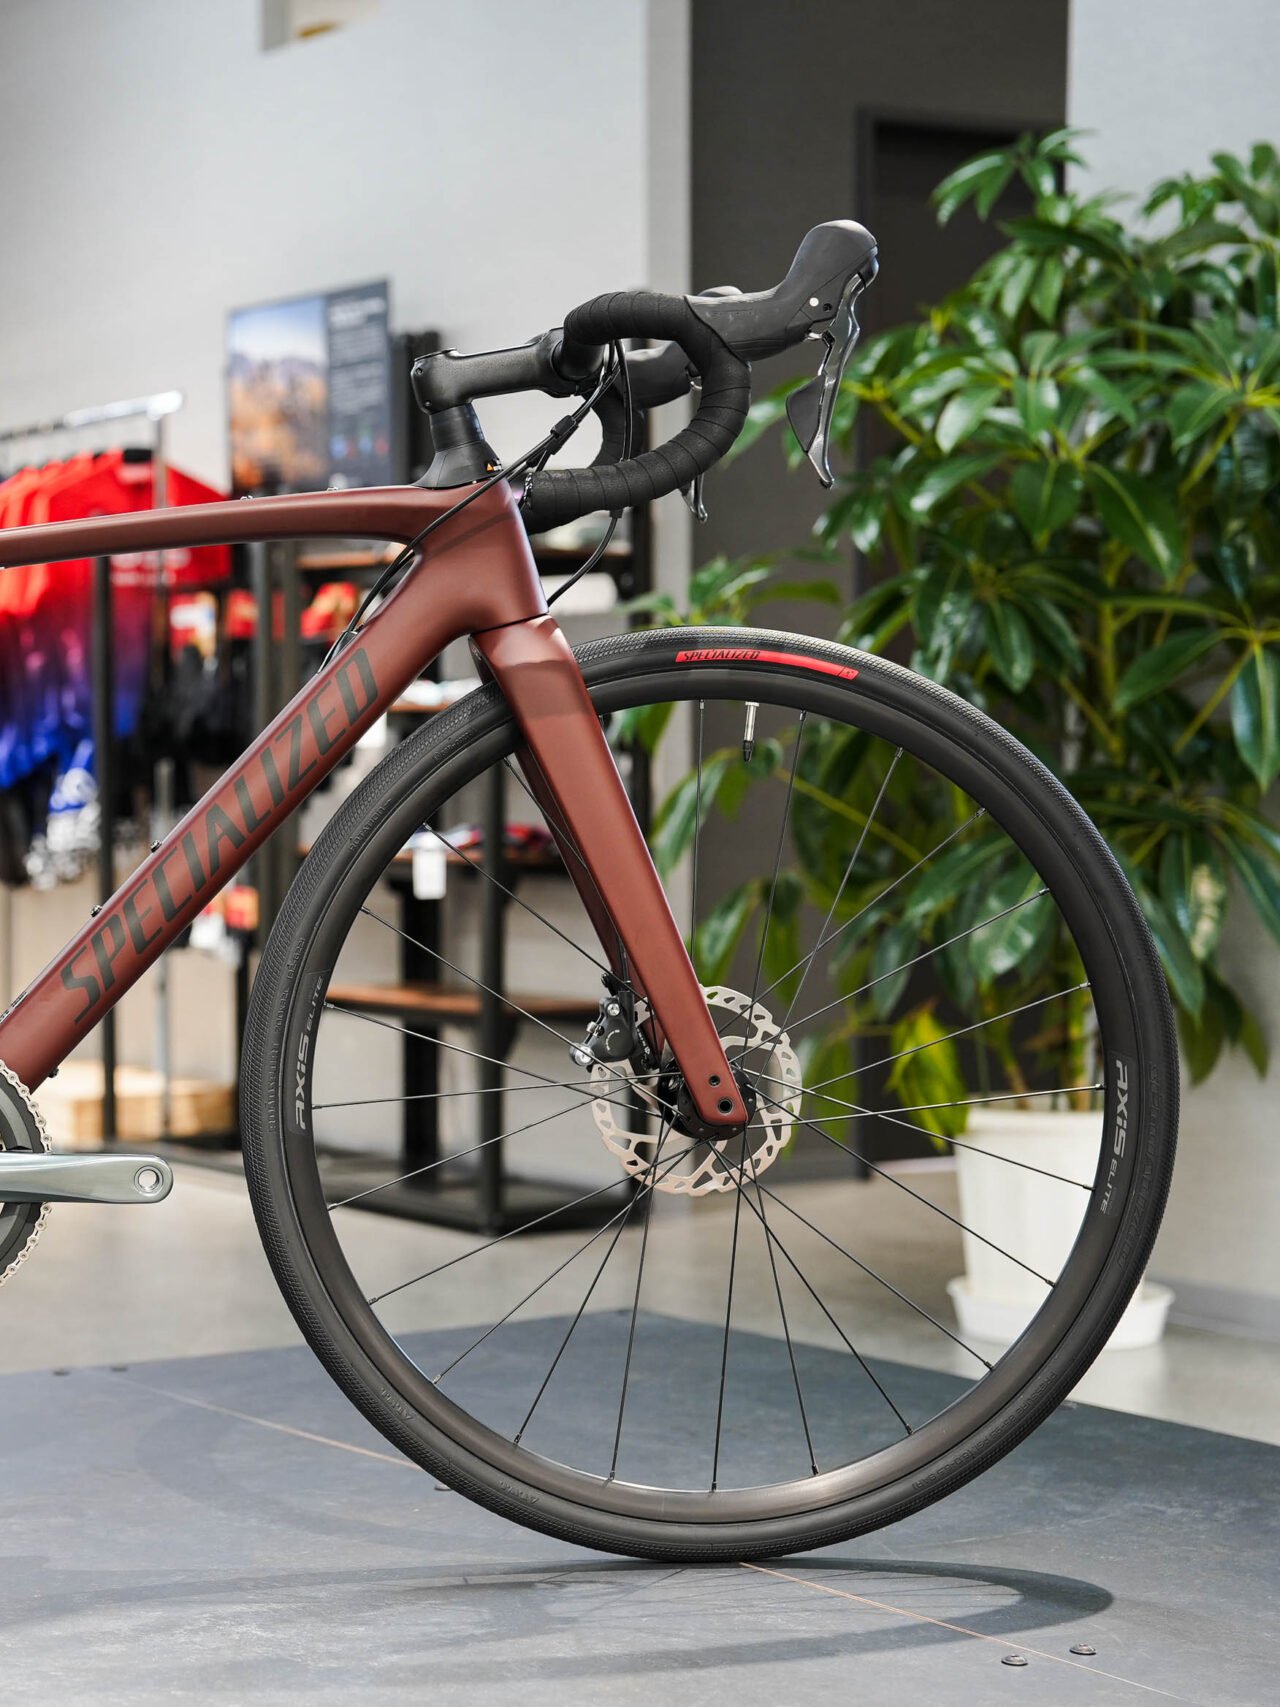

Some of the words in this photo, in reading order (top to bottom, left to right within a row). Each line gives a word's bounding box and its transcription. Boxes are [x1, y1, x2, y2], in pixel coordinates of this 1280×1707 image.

[683, 651, 761, 662] SPECIALIZED
[61, 647, 379, 1025] SPECIALIZED
[306, 975, 324, 1031] ELITE
[1100, 1158, 1118, 1216] ELITE
